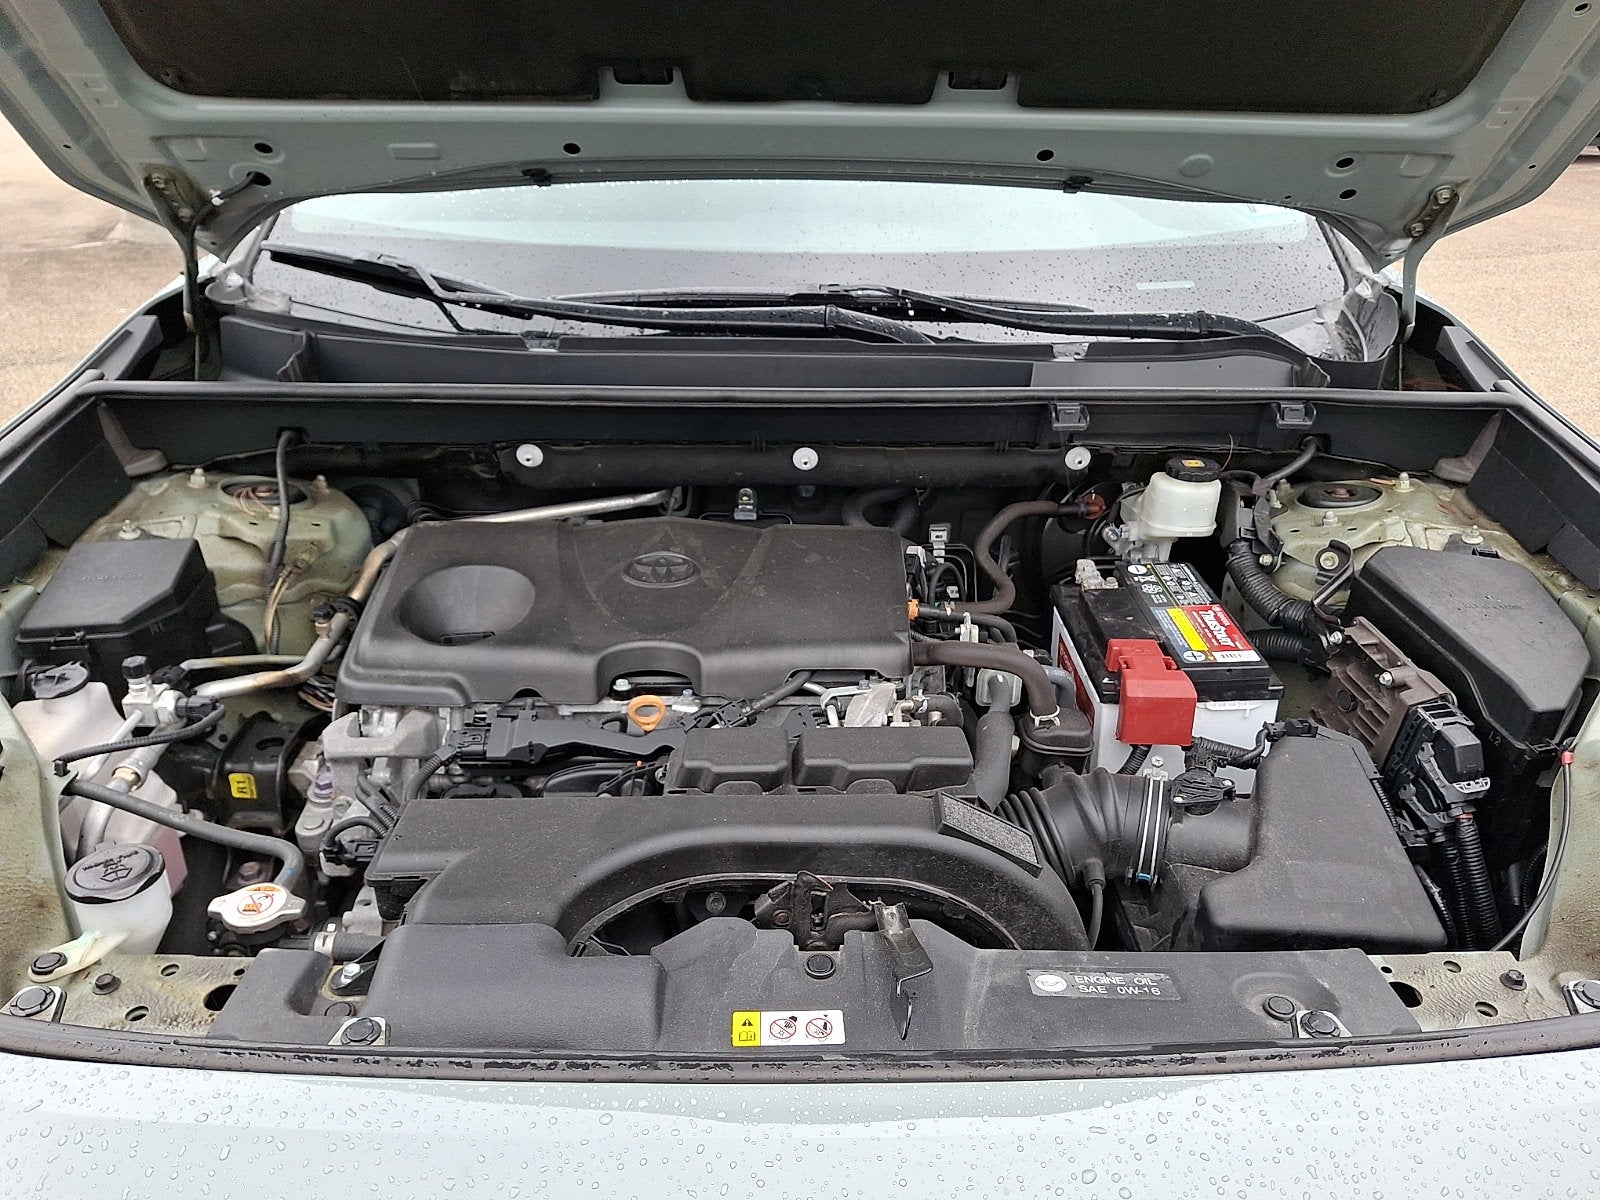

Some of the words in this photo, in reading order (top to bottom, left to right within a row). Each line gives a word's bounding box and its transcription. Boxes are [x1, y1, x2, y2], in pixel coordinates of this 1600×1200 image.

[1074, 975, 1126, 985] ENGINE
[1133, 977, 1158, 986] OIL
[1078, 984, 1108, 994] SAE
[1117, 986, 1161, 996] 0W-16
